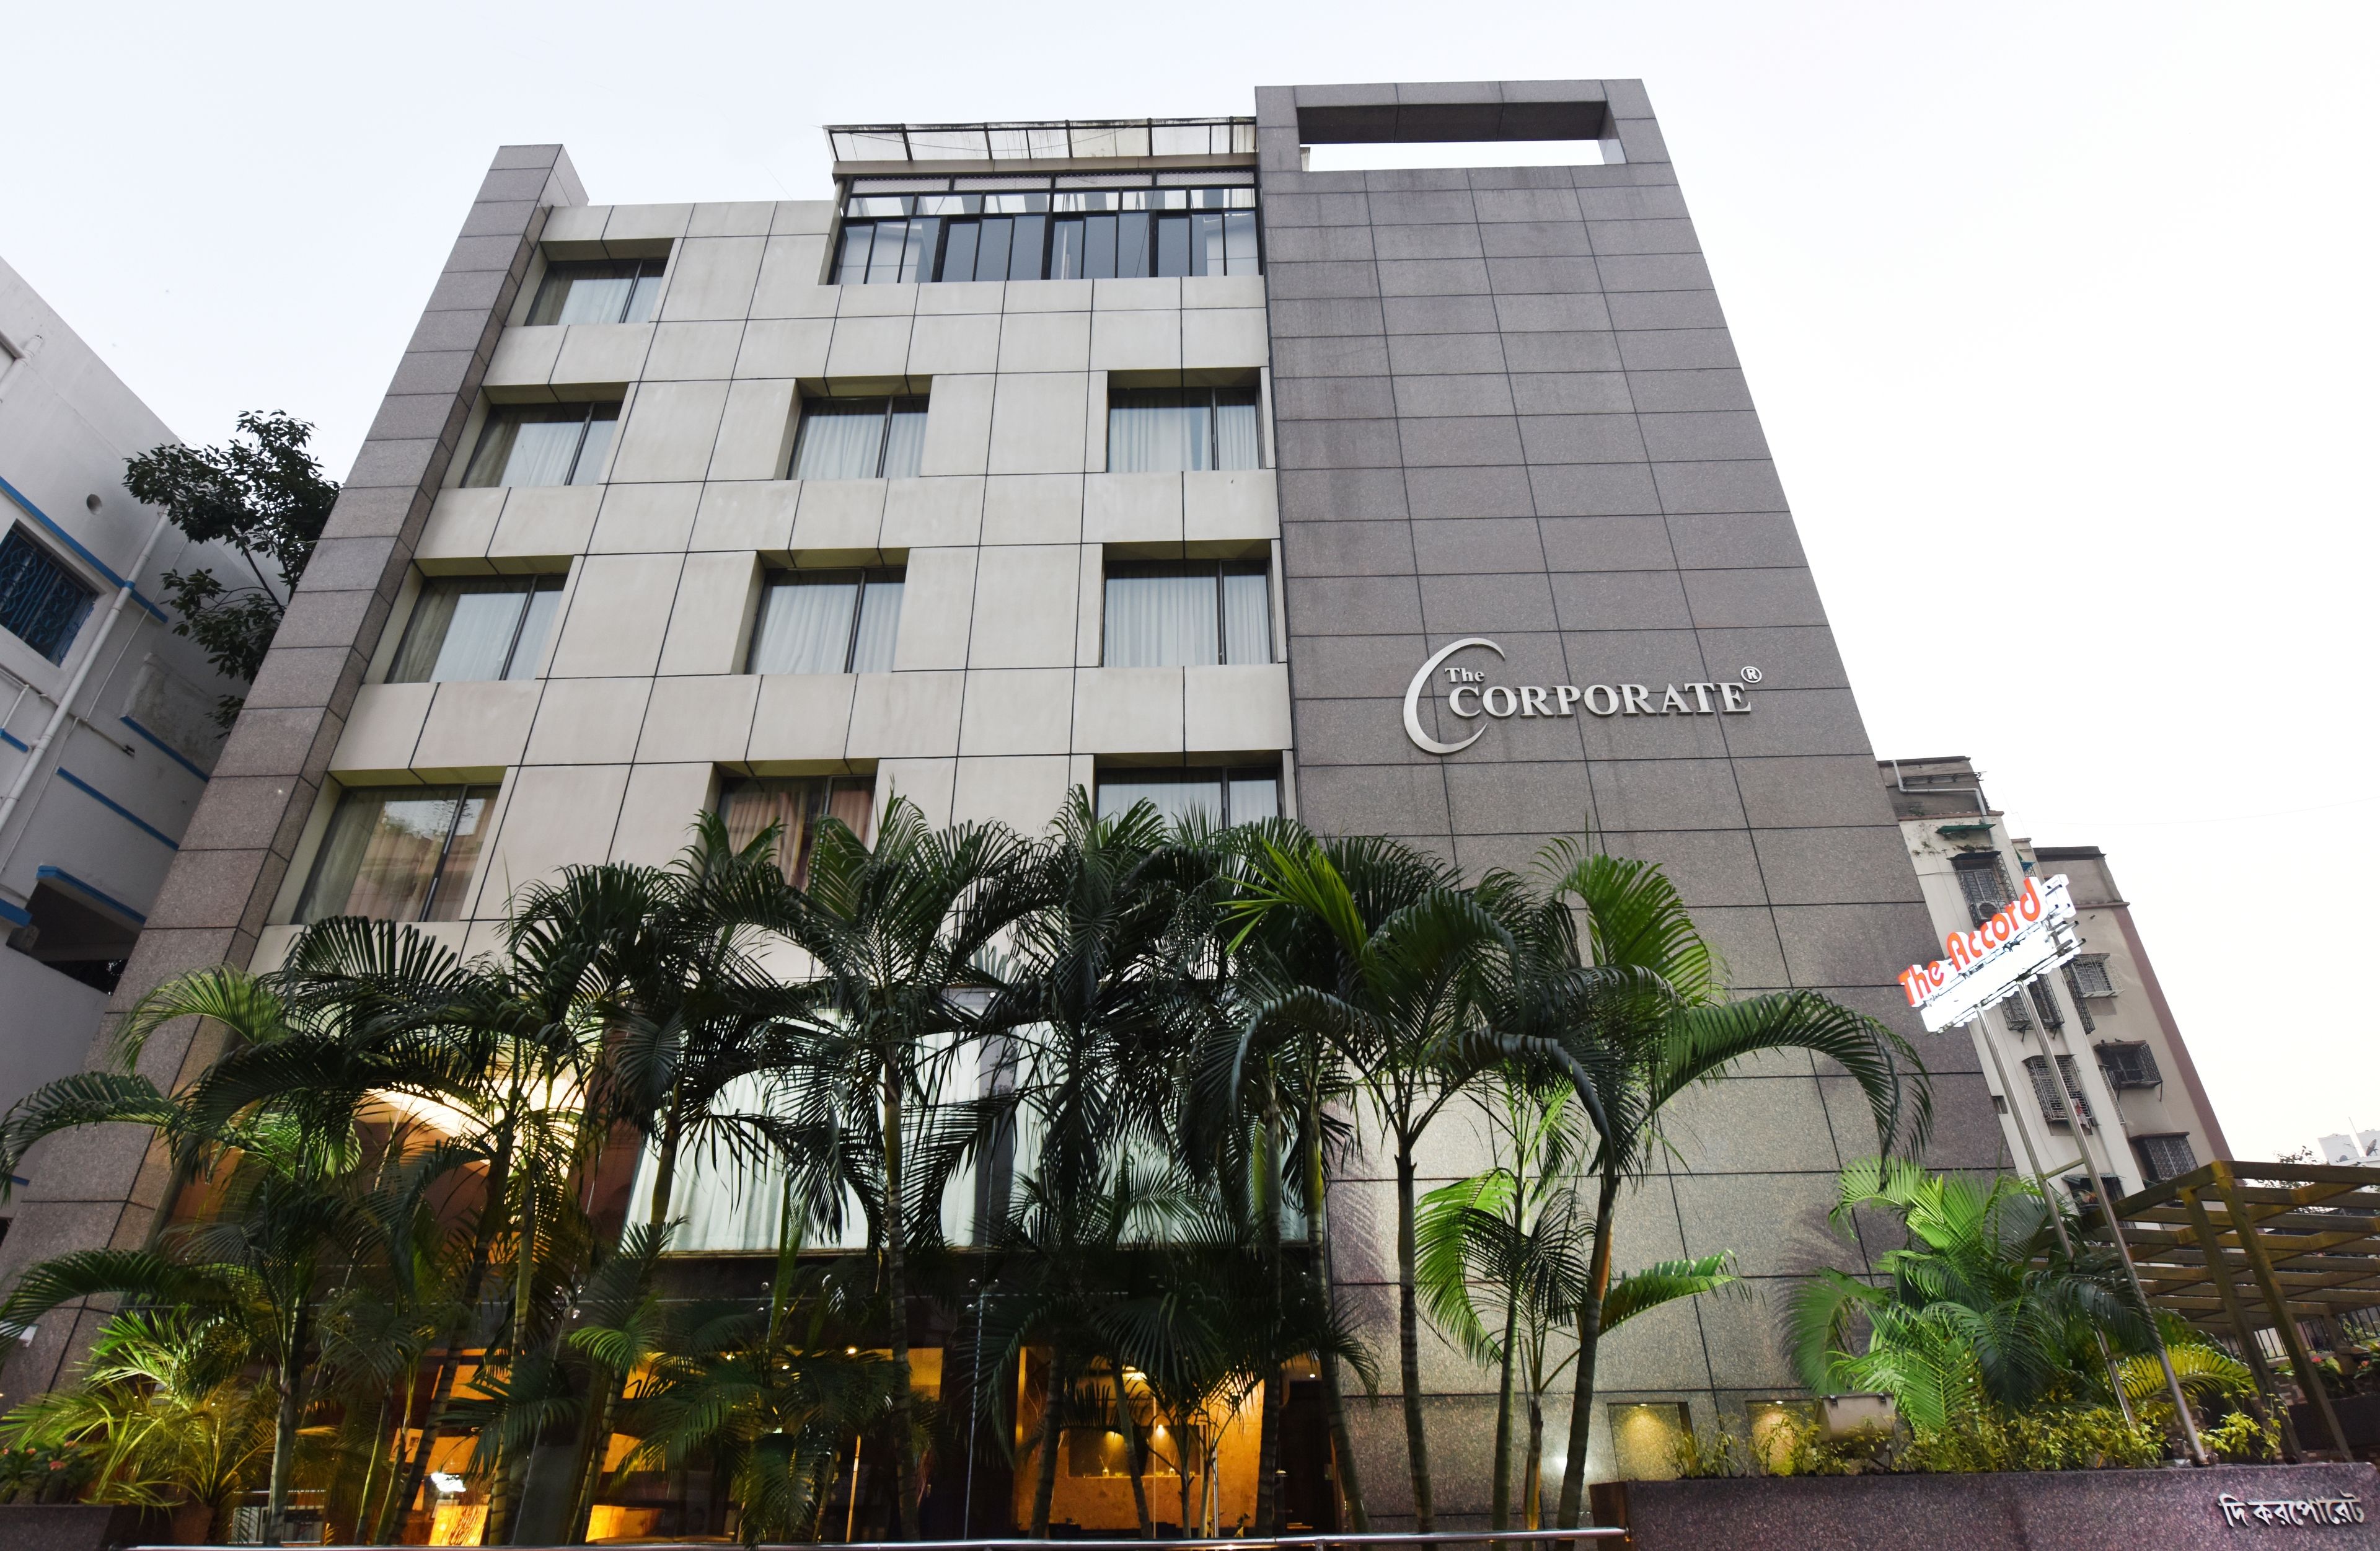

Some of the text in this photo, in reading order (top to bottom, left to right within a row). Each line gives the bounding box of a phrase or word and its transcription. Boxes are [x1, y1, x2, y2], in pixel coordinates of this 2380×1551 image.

[1444, 668, 1485, 683] The
[1898, 877, 2041, 1007] The Accord
[2218, 1490, 2365, 1527] দি করপোরেট
